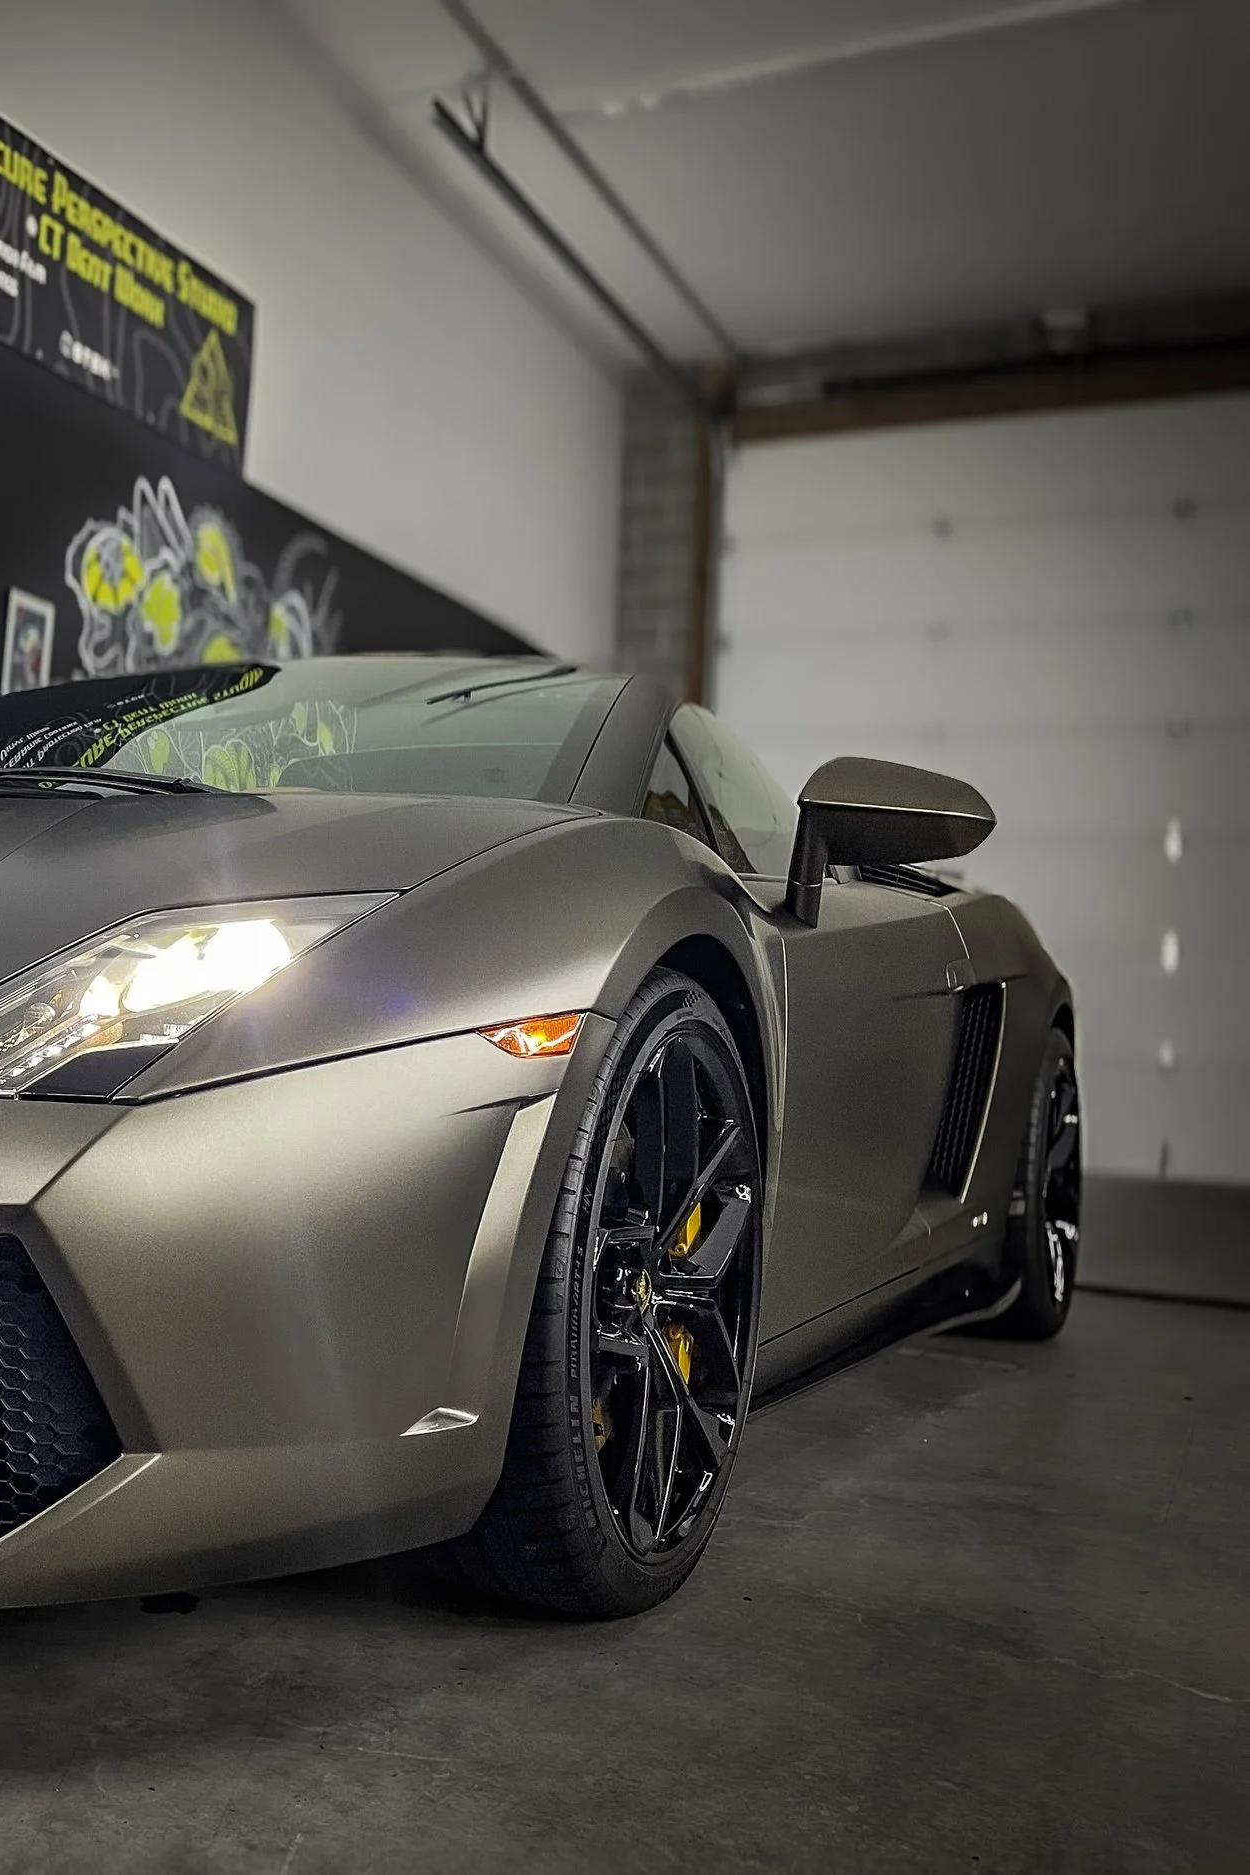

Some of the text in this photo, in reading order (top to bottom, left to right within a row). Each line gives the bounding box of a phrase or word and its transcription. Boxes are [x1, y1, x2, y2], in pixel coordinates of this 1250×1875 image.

[38, 212, 65, 262] CT
[66, 231, 112, 294] DENT
[52, 170, 175, 294] PERSPECTIVE
[568, 1394, 598, 1529] MICHELIN
